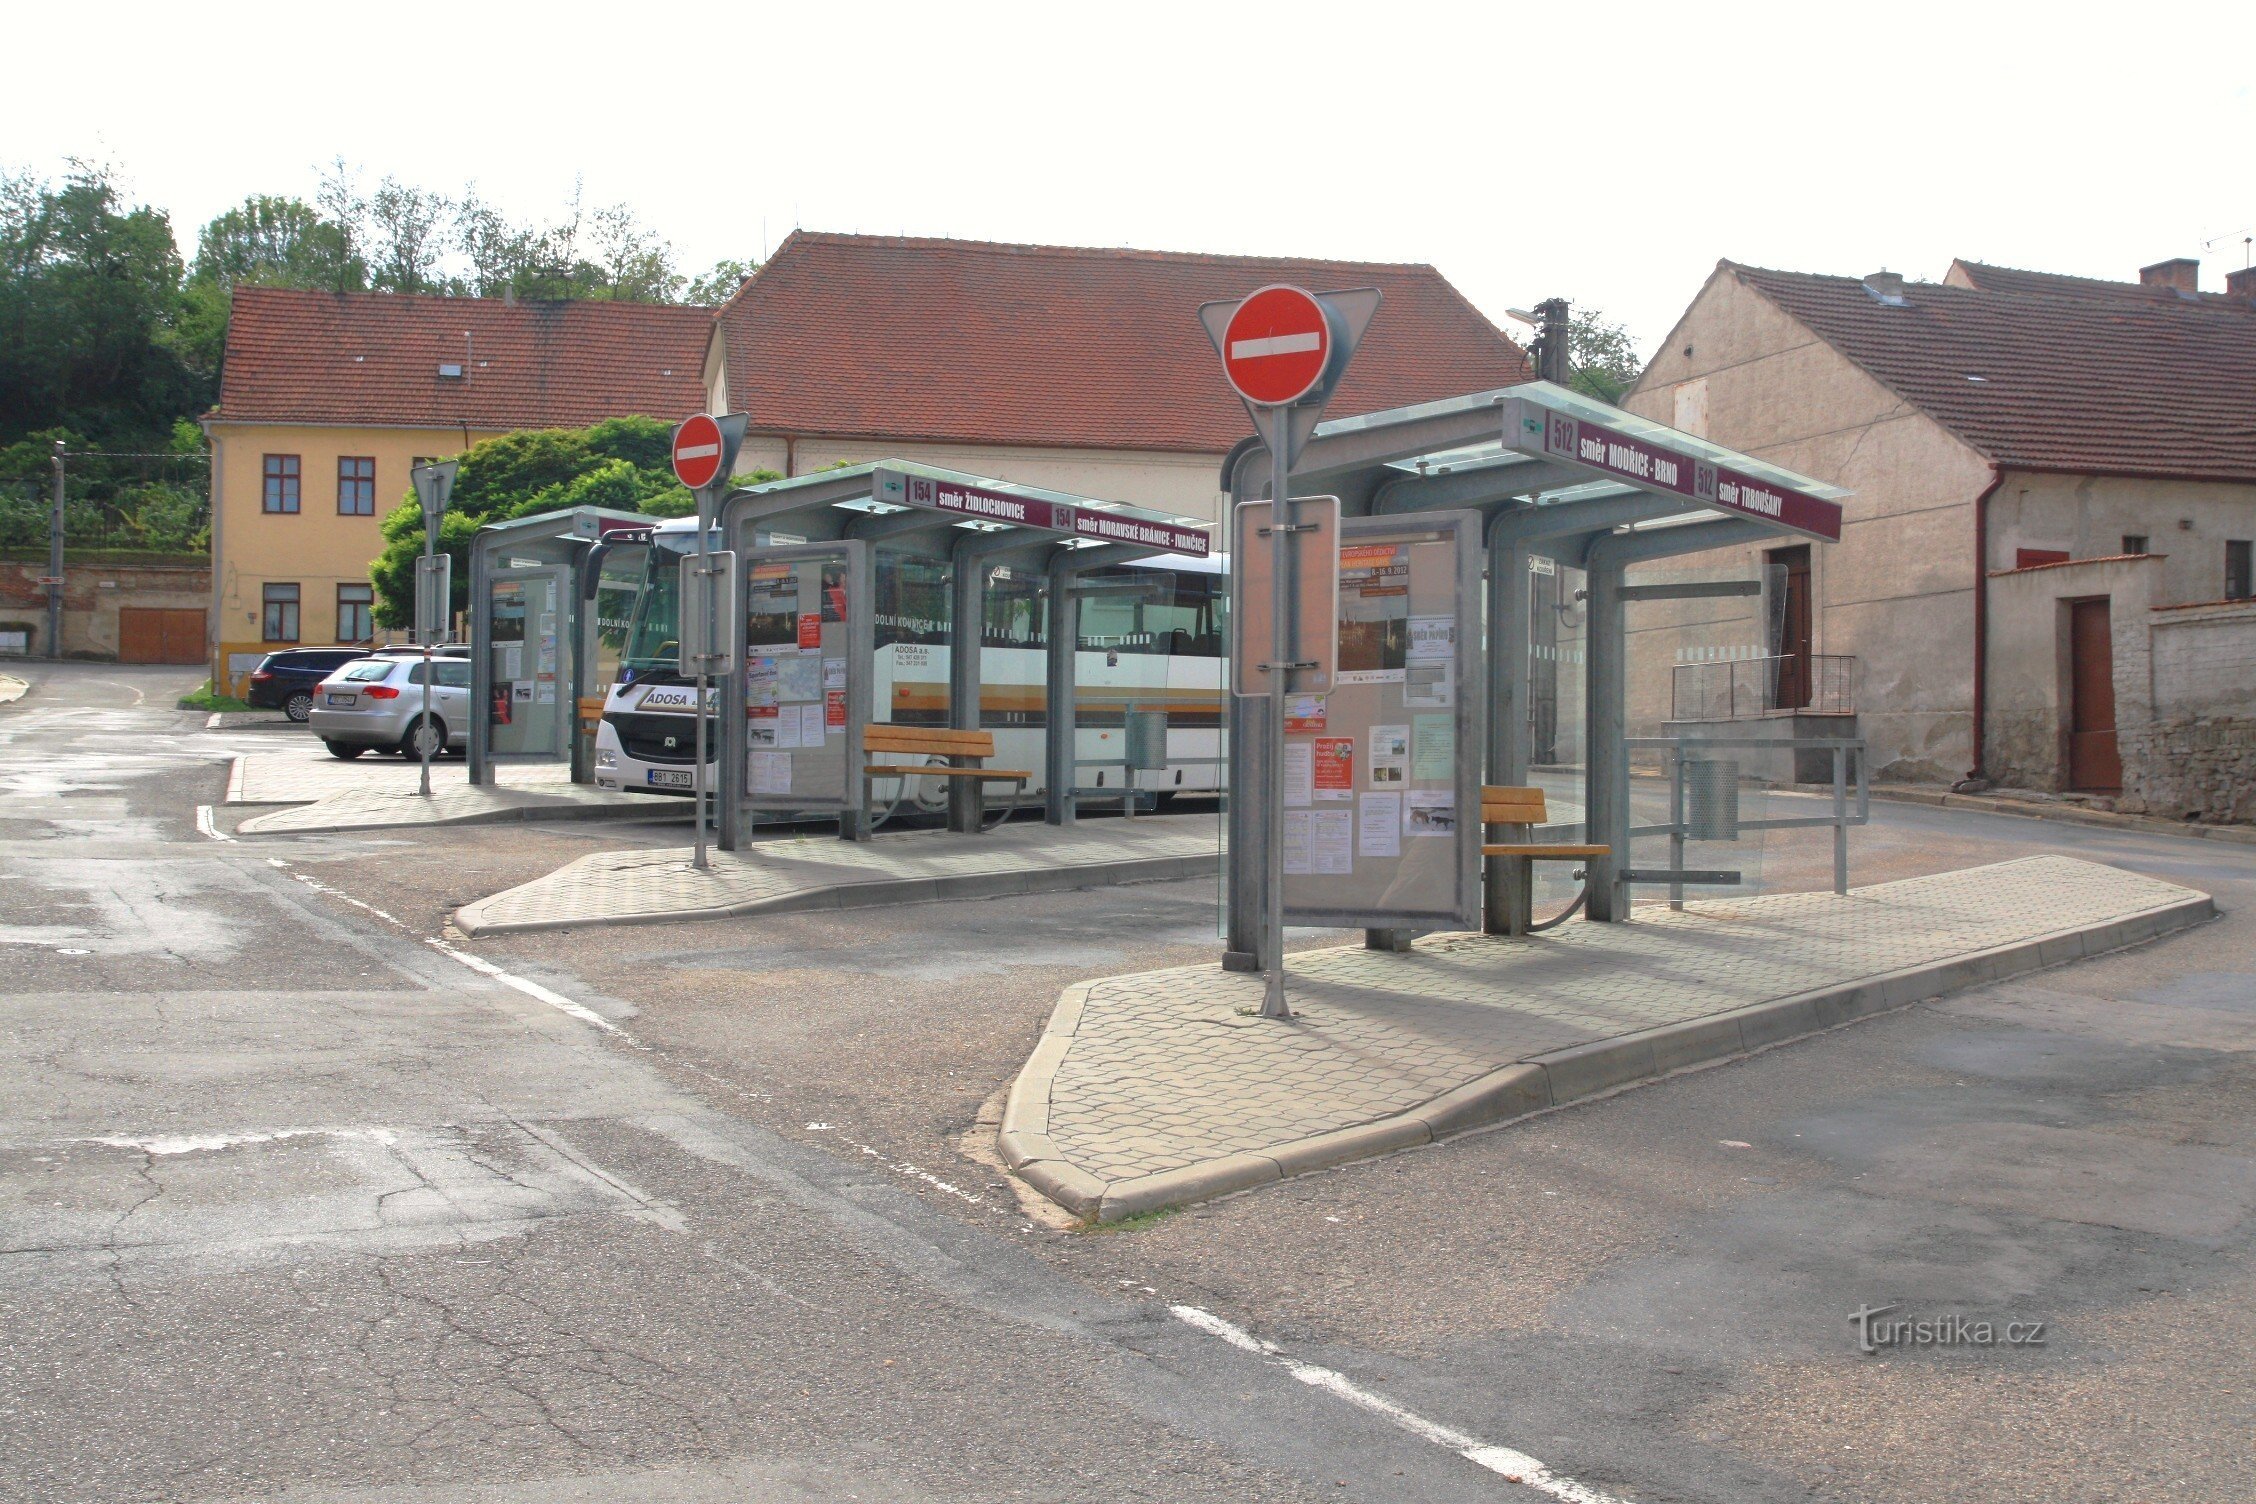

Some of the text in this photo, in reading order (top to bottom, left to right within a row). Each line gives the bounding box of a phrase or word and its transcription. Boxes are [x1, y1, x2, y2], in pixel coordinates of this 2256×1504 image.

[1554, 418, 1573, 452] 512
[1580, 438, 1606, 464] směr
[1608, 443, 1649, 478] MODŘICE
[1654, 458, 1678, 486] BRNO
[1698, 466, 1713, 495] 512
[913, 480, 931, 502] 154
[1719, 481, 1783, 517] směr TRBOUŠANY
[939, 491, 1025, 520] směr ŽIDLOCHOVICE
[1055, 508, 1071, 527] 154
[1077, 517, 1099, 533] směr
[1099, 520, 1139, 540] MORAVSKÉ
[1139, 526, 1170, 546] BRÁNICE
[1174, 533, 1207, 552] IVANČICE
[1393, 566, 1407, 575] 2012
[602, 617, 620, 627] DOLNÍ
[875, 613, 896, 627] DOLNÍ
[895, 645, 918, 654] ADOSA
[646, 693, 687, 706] ADOSA
[671, 773, 688, 784] 2615
